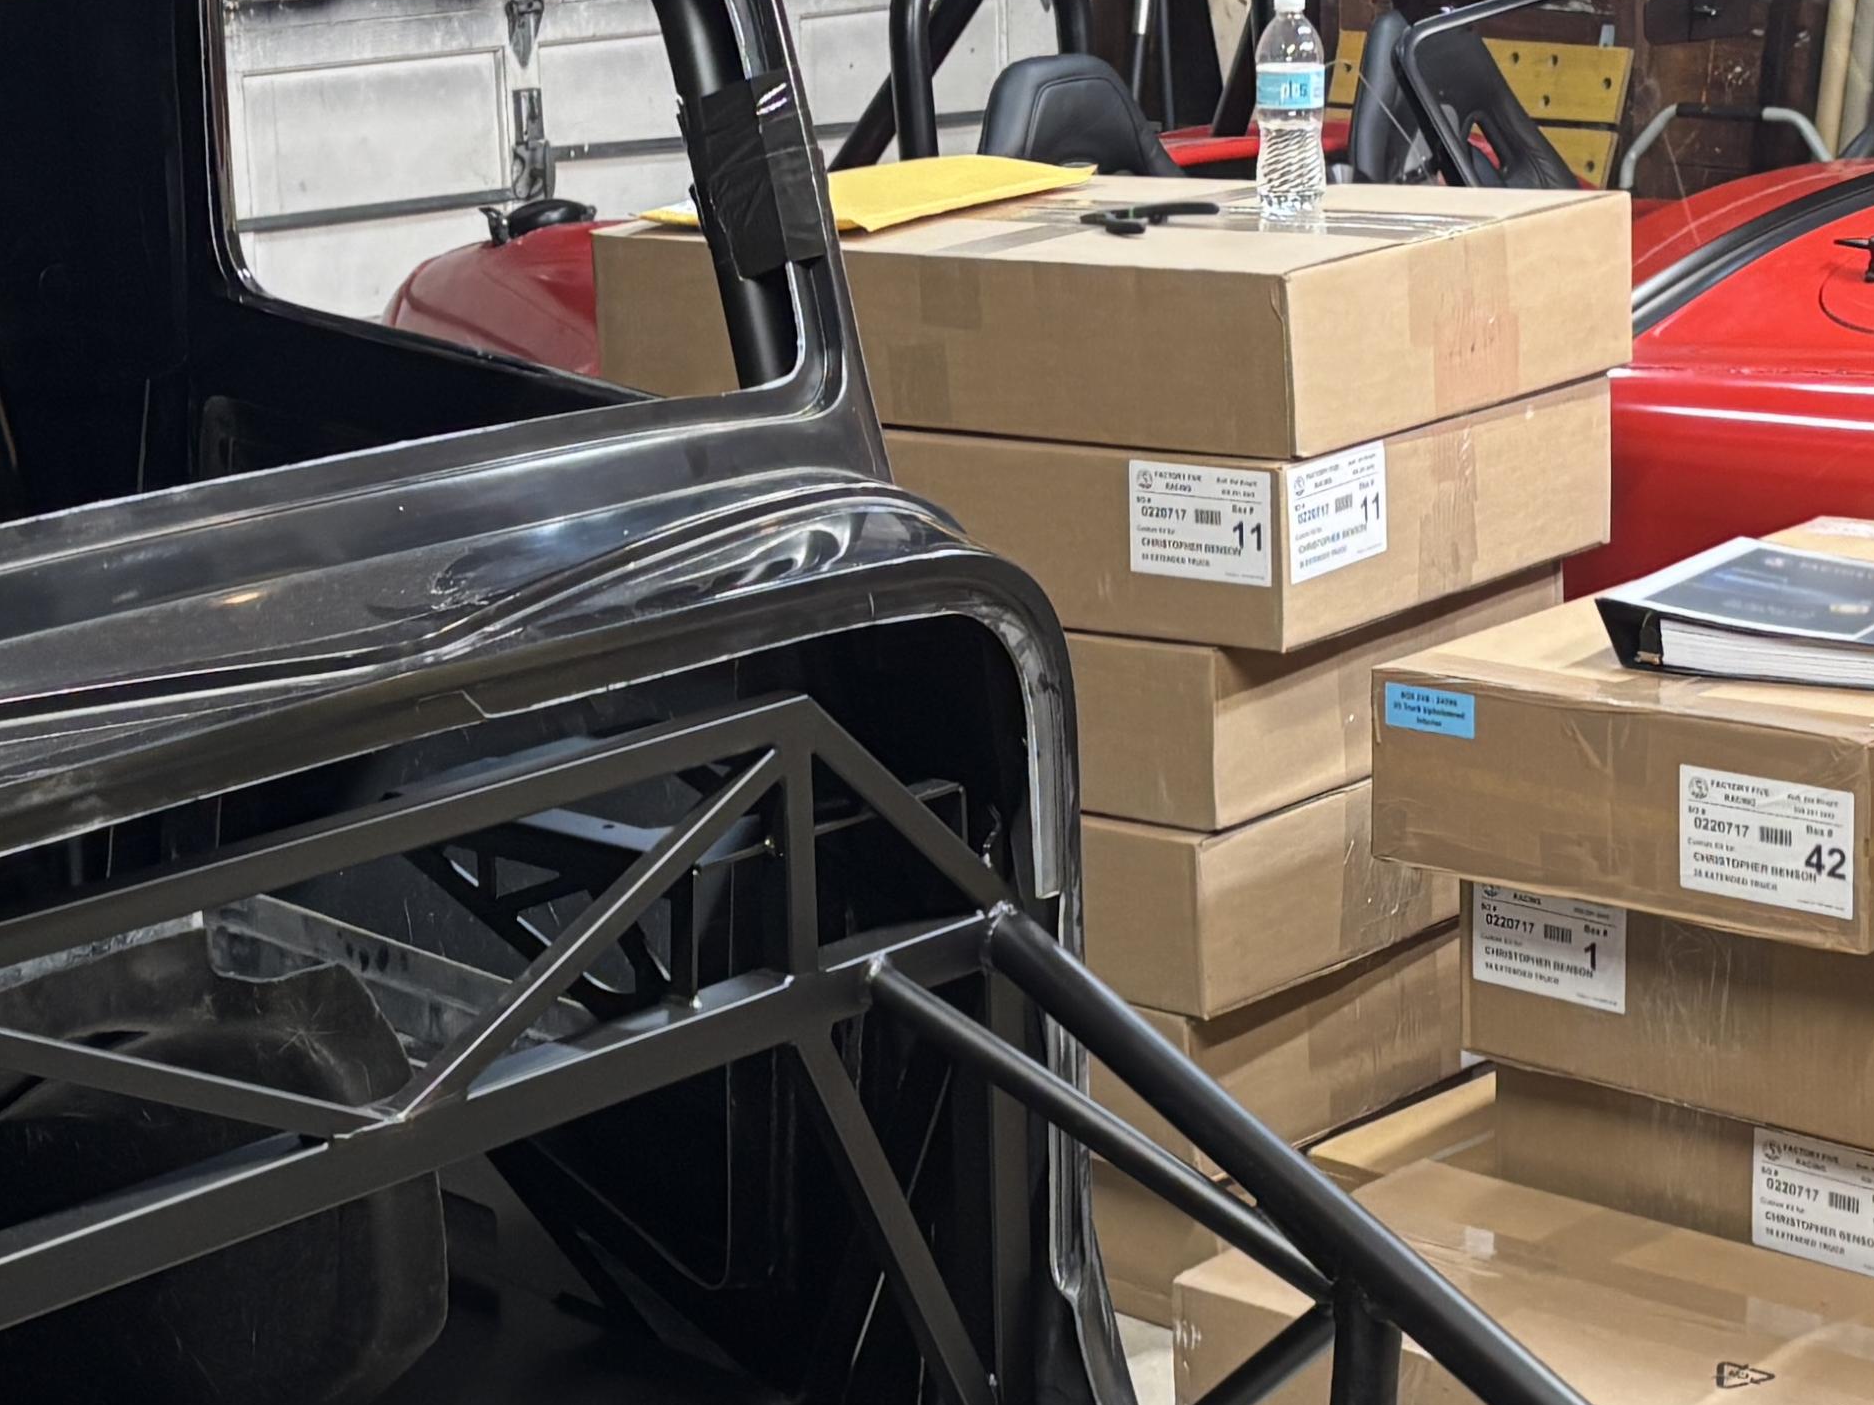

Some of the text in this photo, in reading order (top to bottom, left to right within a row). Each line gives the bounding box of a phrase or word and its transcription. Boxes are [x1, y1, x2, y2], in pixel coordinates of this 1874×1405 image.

[1359, 490, 1380, 525] 11
[1231, 520, 1262, 552] 11
[1803, 841, 1846, 881] 42
[1581, 939, 1597, 971] 1
